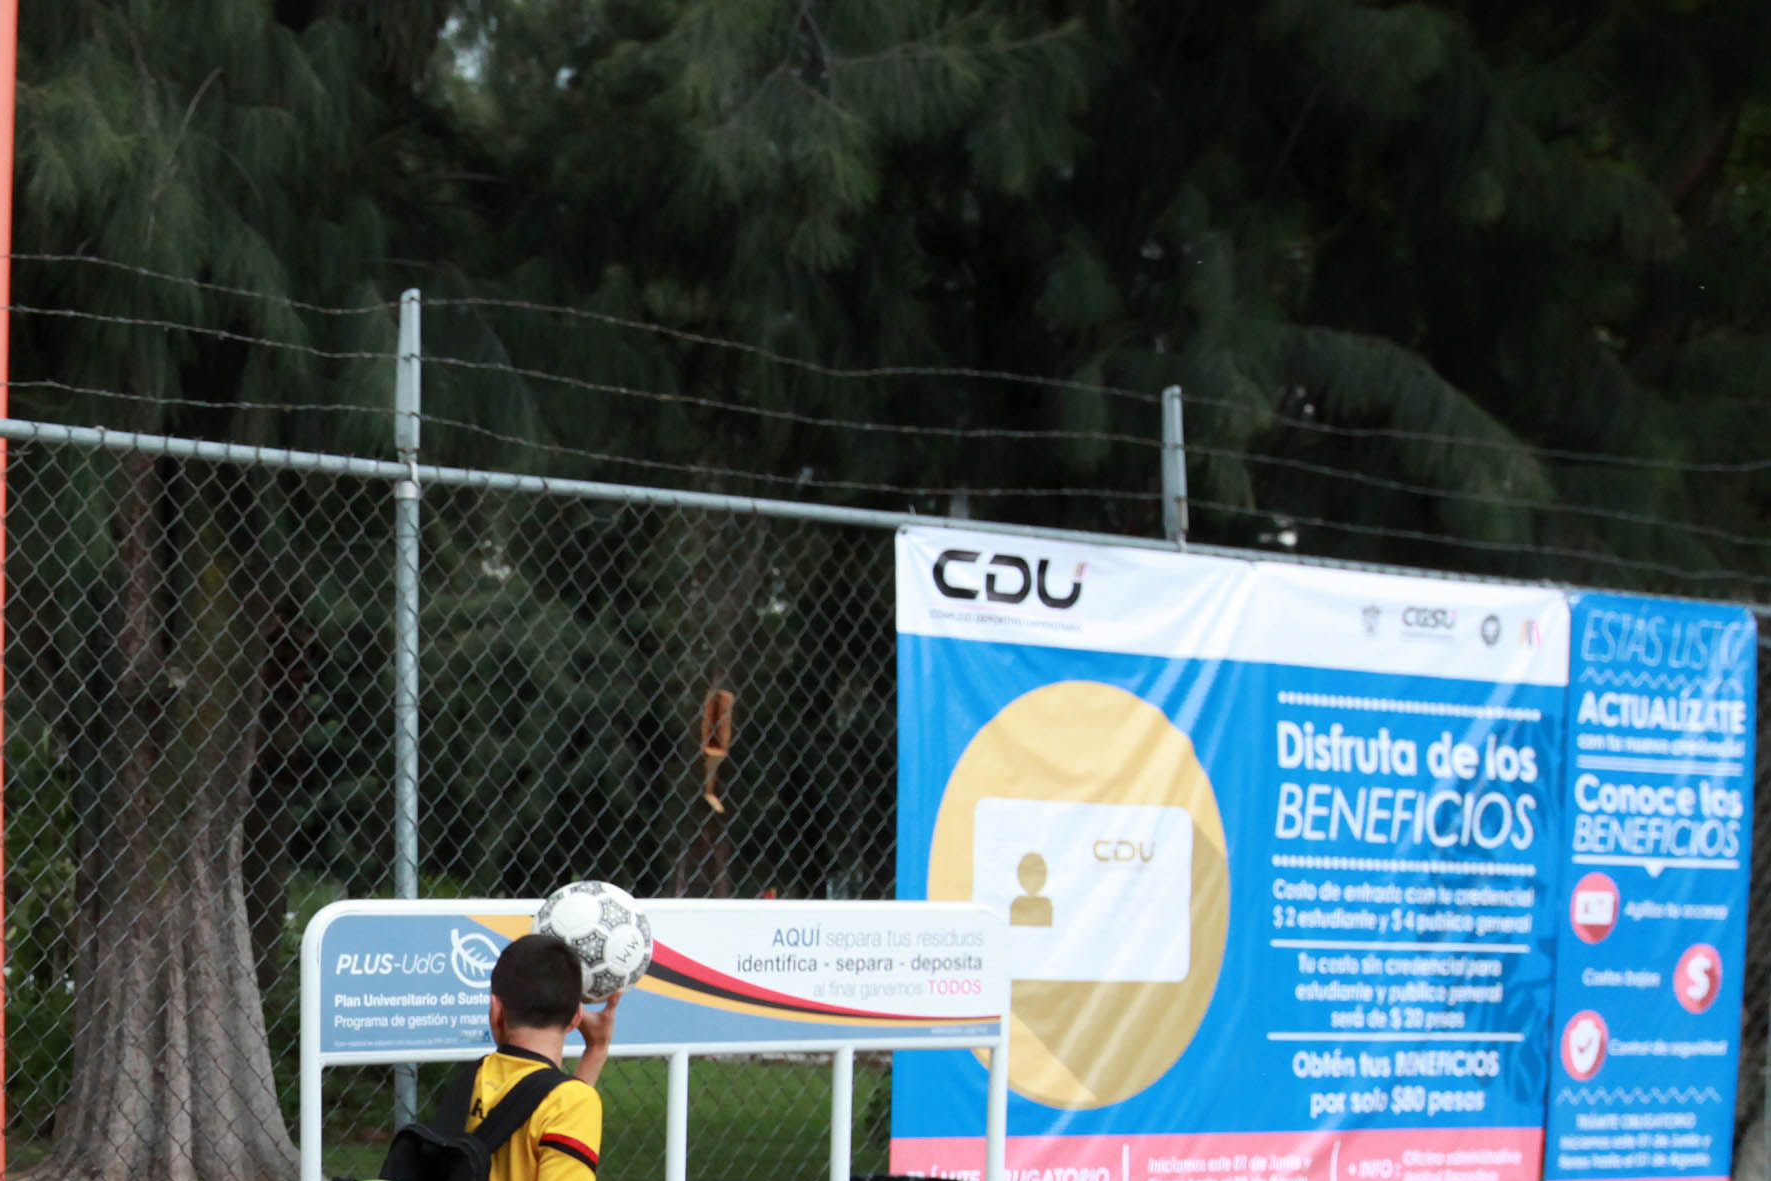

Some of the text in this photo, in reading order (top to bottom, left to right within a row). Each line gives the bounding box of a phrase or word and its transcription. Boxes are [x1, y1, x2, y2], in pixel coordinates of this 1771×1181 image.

[932, 549, 1089, 609] CDU
[1276, 719, 1538, 784] Disfruta de los
[1574, 773, 1743, 819] Conoce los
[1275, 782, 1537, 850] BENEFICIOS
[1572, 814, 1740, 858] BENEFICIOS
[1092, 839, 1156, 864] CDU
[772, 923, 983, 951] AQUÍ separa tus residuos
[335, 952, 446, 975] PLUS-UdG
[737, 954, 817, 972] identifica
[835, 956, 893, 976] separa
[910, 953, 983, 976] deposita
[334, 994, 361, 1008] Plan
[363, 993, 437, 1008] Universitario
[440, 992, 455, 1006] de
[928, 979, 982, 996] TODOS
[334, 1014, 388, 1031] Programa
[391, 1014, 405, 1027] de
[408, 1012, 449, 1029] gestión
[450, 1016, 458, 1028] y
[1292, 1048, 1356, 1078] Obtén
[1359, 1051, 1391, 1078] tus
[1310, 1091, 1347, 1119] por
[1427, 1089, 1486, 1118] pesos
